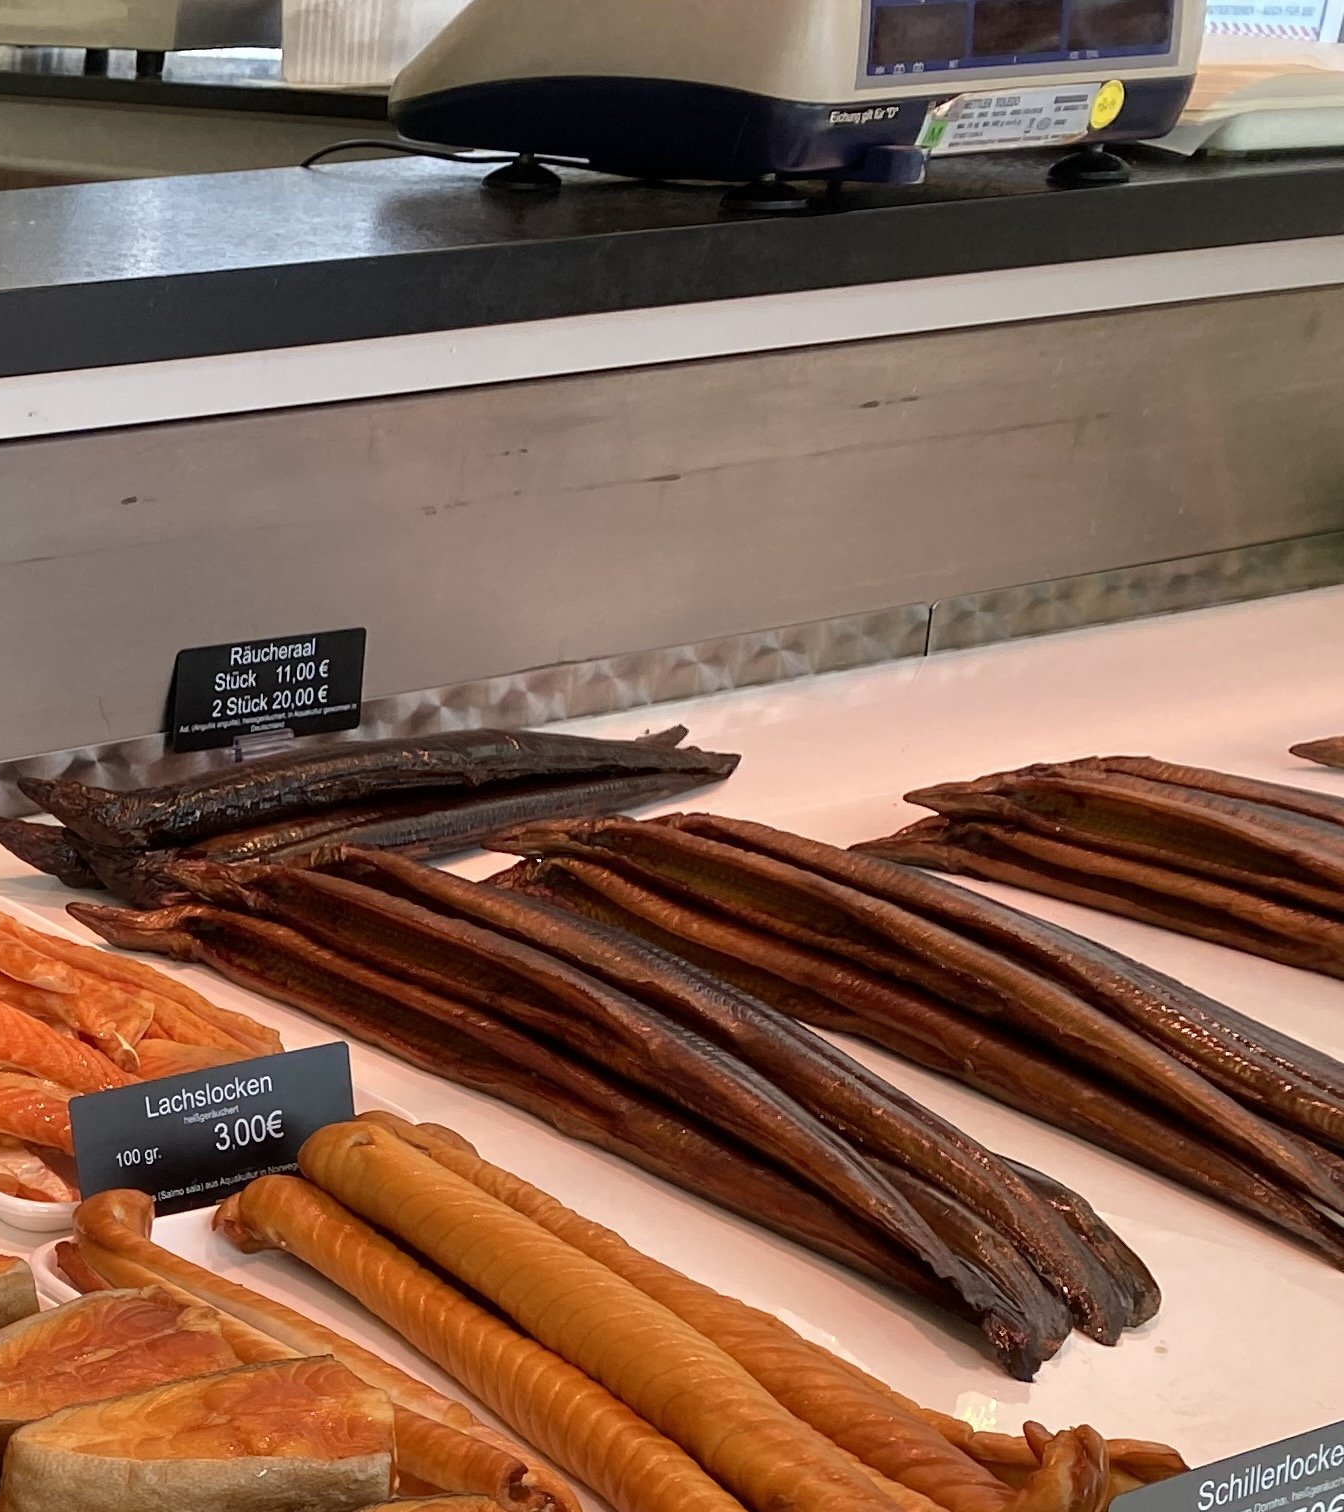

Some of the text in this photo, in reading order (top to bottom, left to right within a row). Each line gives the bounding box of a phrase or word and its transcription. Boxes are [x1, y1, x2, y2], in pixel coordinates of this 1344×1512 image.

[231, 638, 315, 666] Räucheraal
[215, 660, 329, 691] Stück 11,00 €
[212, 685, 328, 717] 2 Stück 20,00 €
[146, 1076, 272, 1117] Lachslocken
[215, 1110, 284, 1150] 3,00€
[116, 1147, 162, 1167] 100 gr.
